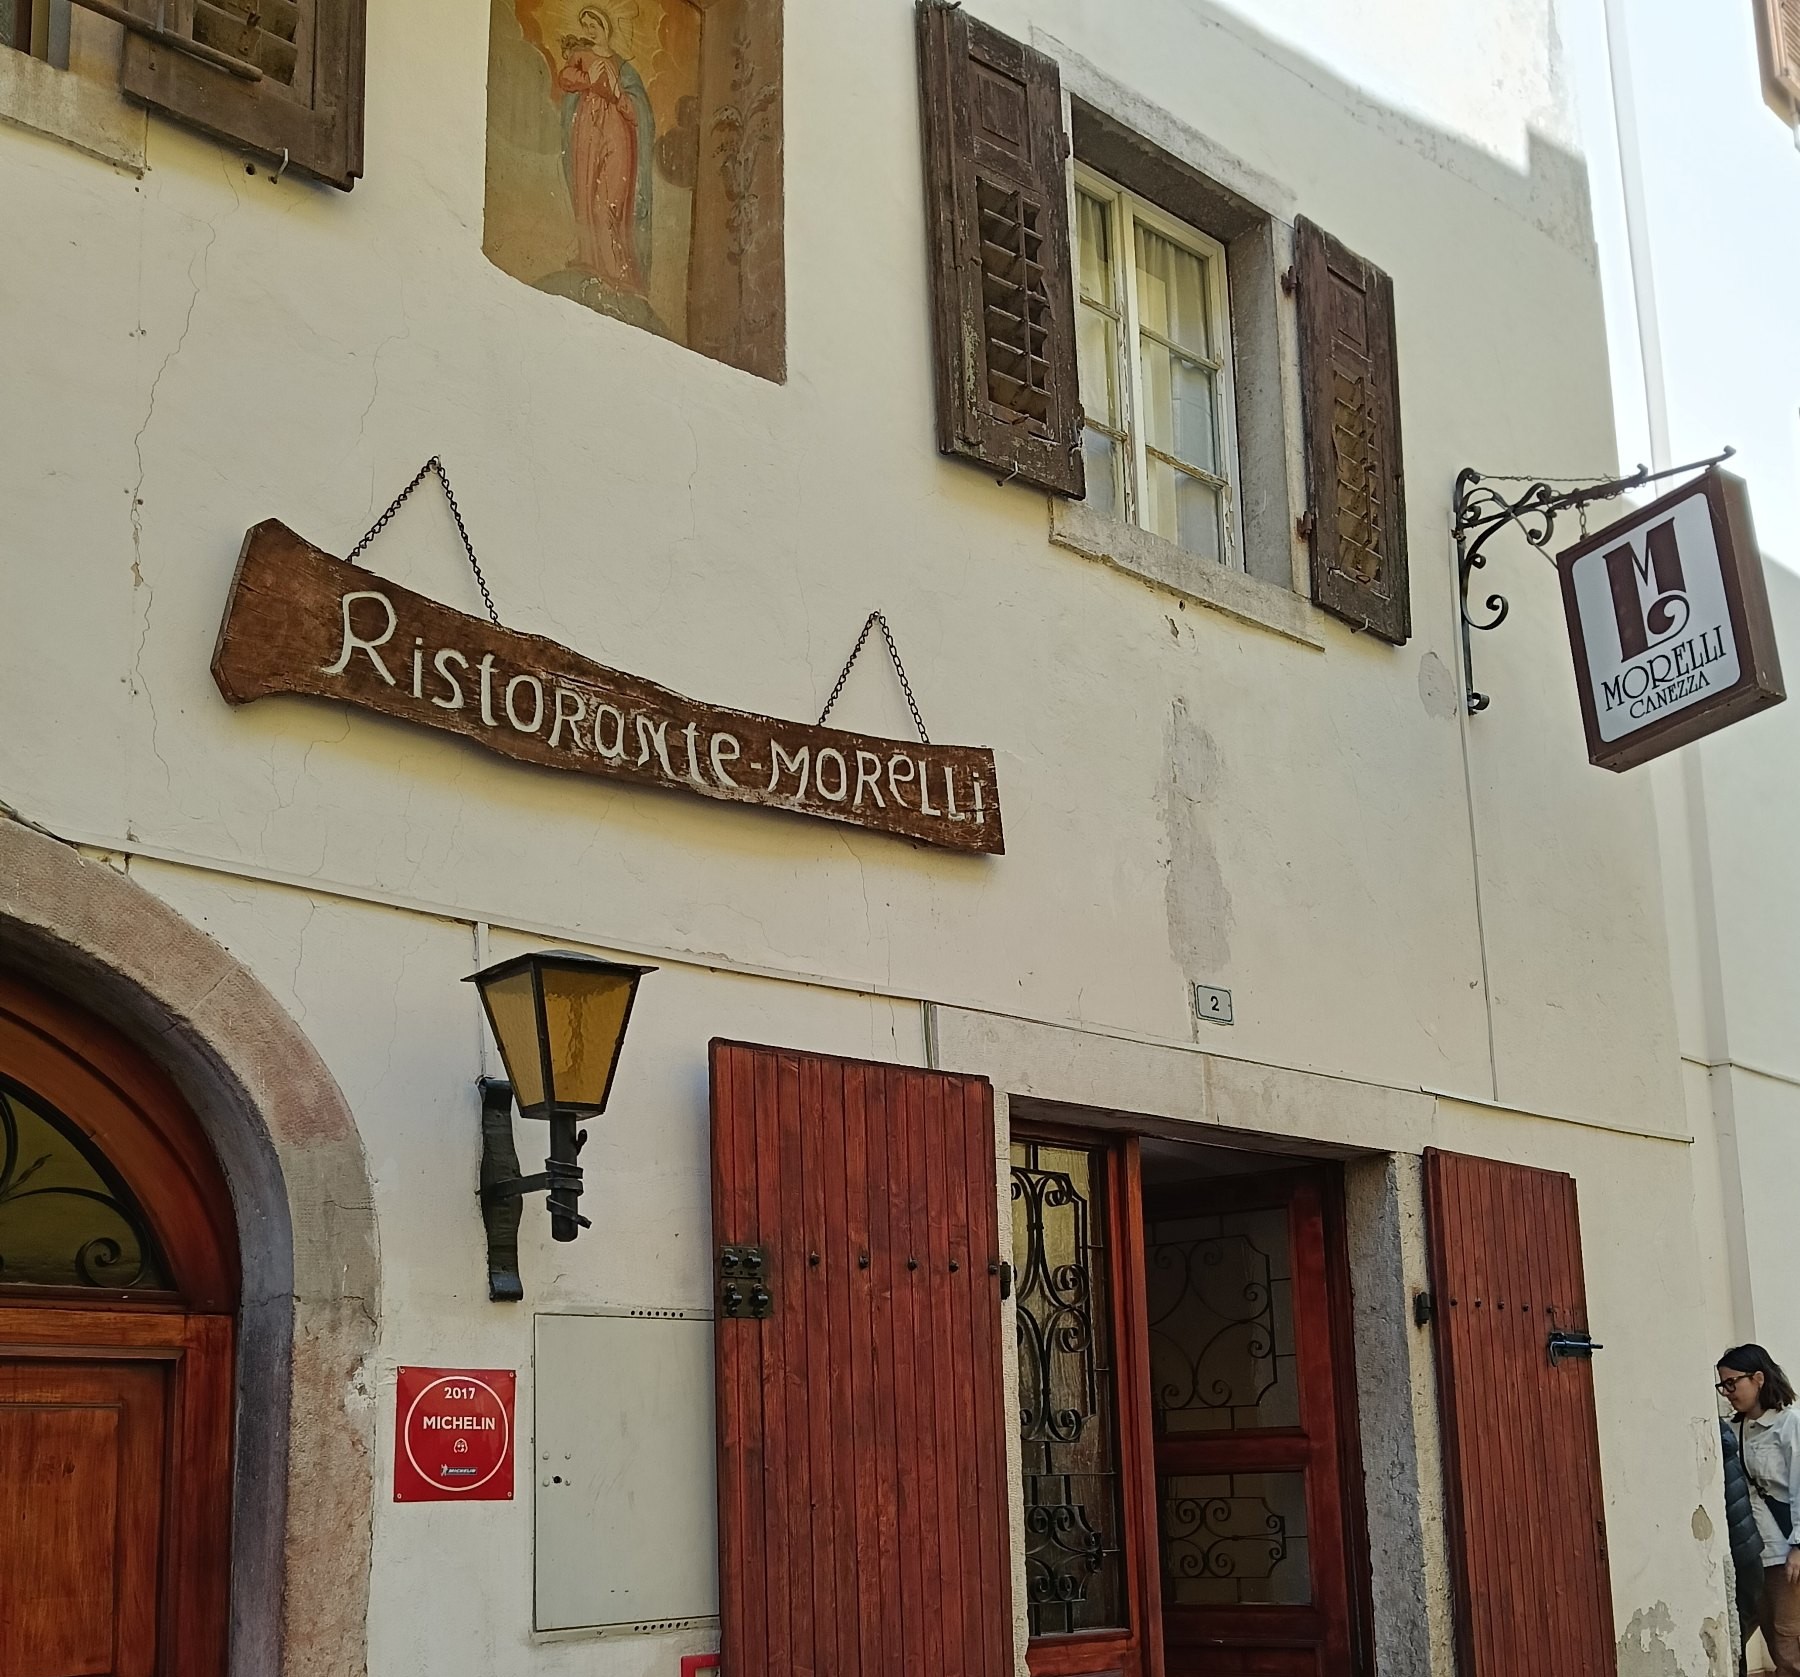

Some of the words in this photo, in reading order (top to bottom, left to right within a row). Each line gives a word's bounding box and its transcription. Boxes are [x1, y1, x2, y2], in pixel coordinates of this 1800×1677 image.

[1601, 625, 1726, 711] MORELLI
[1629, 670, 1710, 719] CANEZZA
[1210, 995, 1220, 1012] 2
[444, 1387, 476, 1399] 2017
[423, 1416, 495, 1430] MICHELIN
